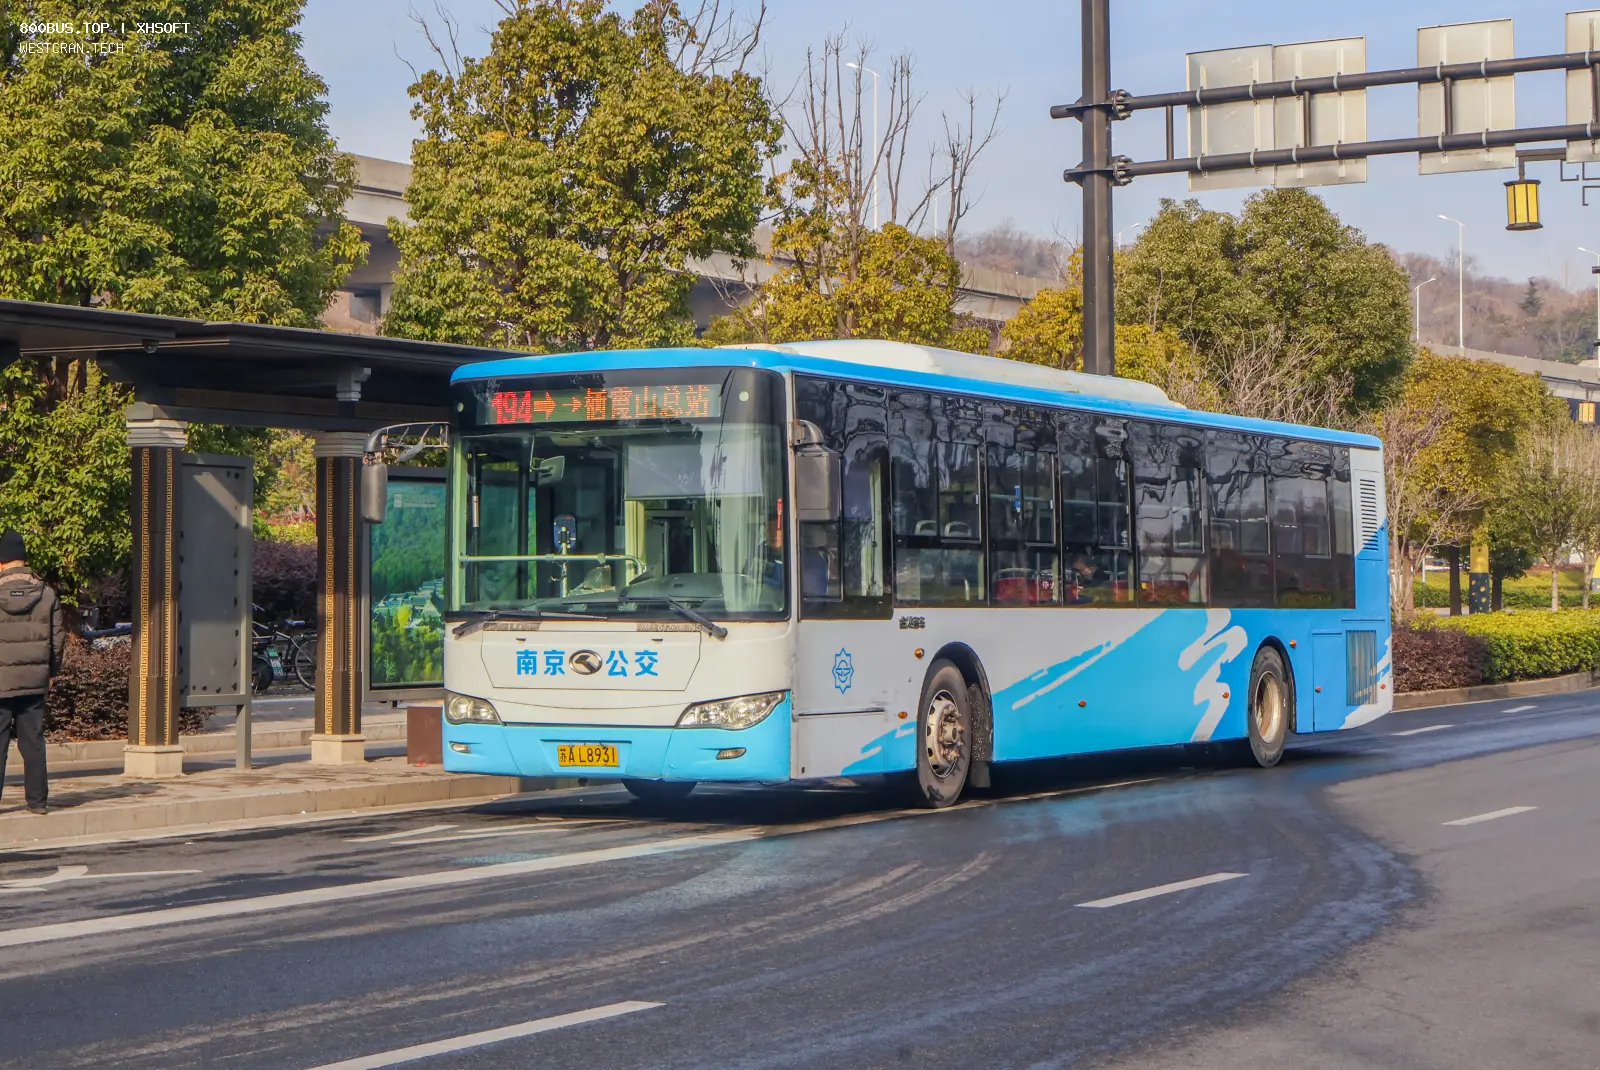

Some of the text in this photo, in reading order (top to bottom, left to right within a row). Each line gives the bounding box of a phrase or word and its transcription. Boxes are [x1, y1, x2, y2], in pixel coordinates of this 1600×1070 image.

[491, 390, 532, 424] 194
[515, 649, 659, 677] 南京 公交
